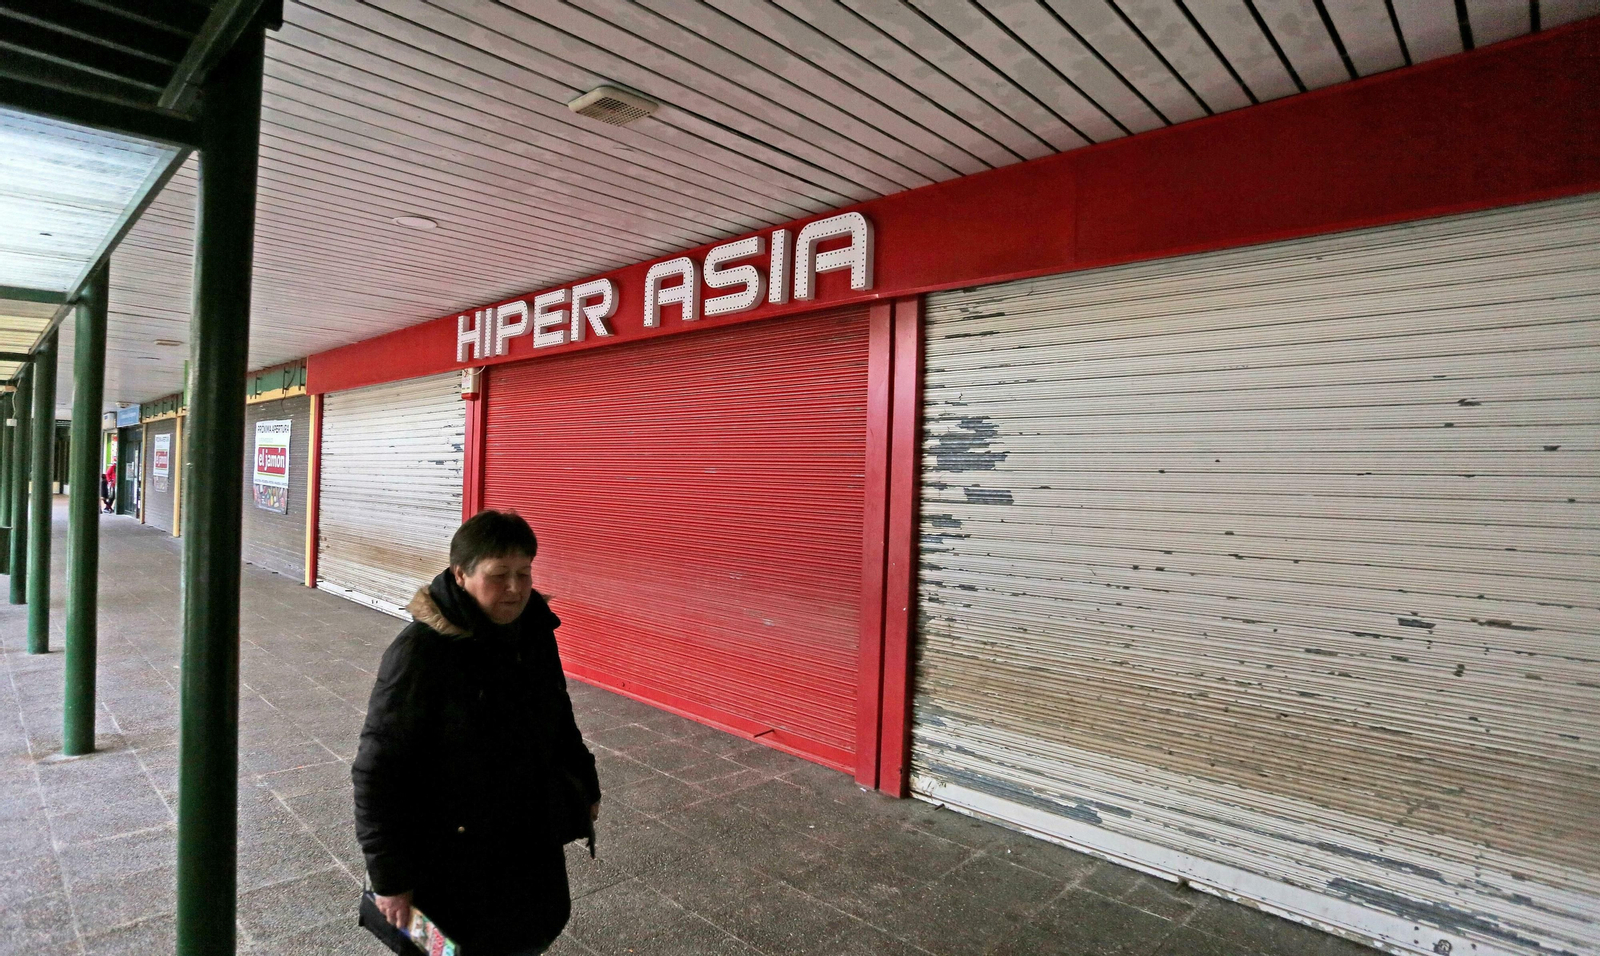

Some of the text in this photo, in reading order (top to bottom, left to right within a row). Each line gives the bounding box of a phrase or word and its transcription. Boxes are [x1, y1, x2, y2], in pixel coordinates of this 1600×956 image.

[456, 211, 874, 363] HIPER ASIA
[258, 447, 285, 471] el jamón
